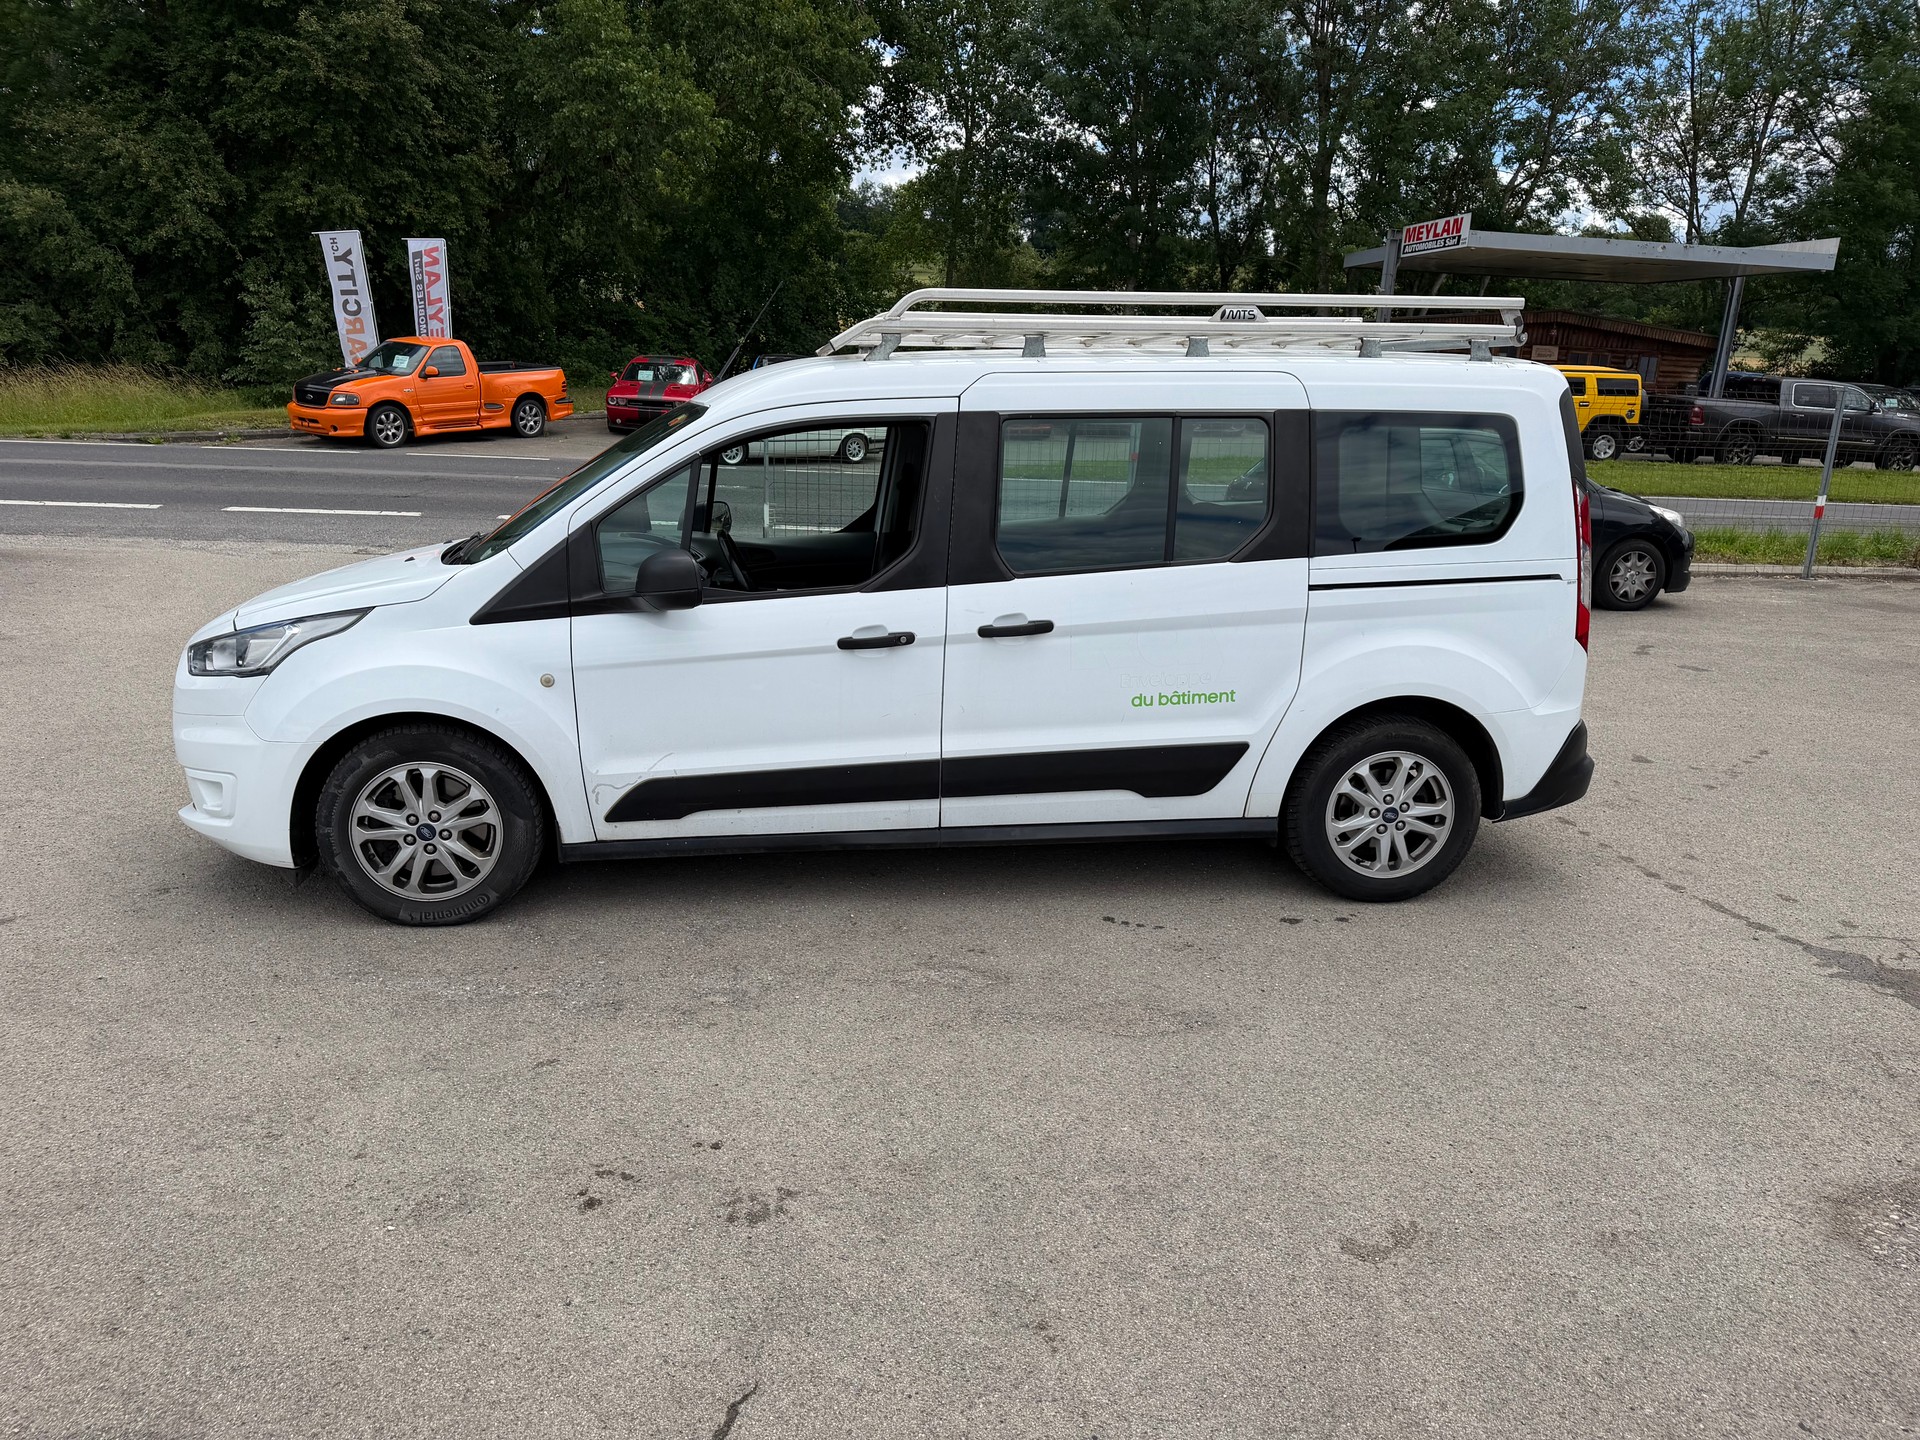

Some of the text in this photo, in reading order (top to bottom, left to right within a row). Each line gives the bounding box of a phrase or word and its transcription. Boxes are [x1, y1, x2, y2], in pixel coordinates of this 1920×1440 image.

[1404, 217, 1464, 243] MEYLAN
[1404, 240, 1445, 253] AUTOMOBILES
[1227, 310, 1256, 320] MTS
[1131, 690, 1236, 707] du bâtiment
[420, 893, 491, 921] Continental
